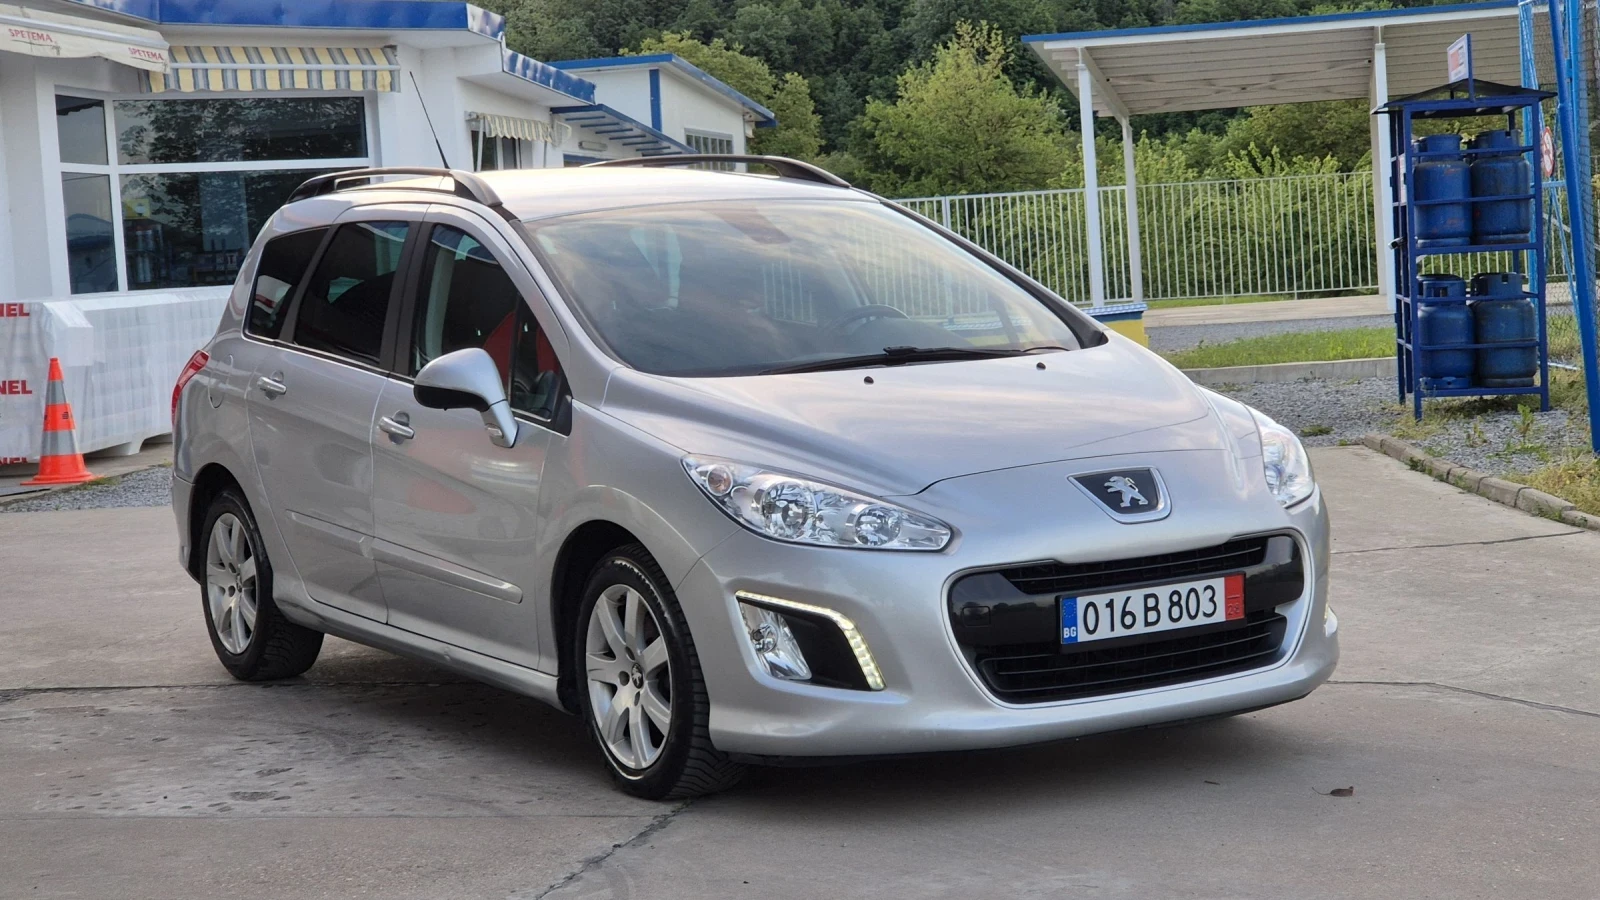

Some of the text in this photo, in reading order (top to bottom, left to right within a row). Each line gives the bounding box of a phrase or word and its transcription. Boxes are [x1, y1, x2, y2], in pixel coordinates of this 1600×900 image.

[8, 28, 53, 42] SPETEMA
[128, 47, 164, 60] SPETEMA
[1083, 585, 1217, 635] 016 B 803
[1063, 627, 1077, 638] BG
